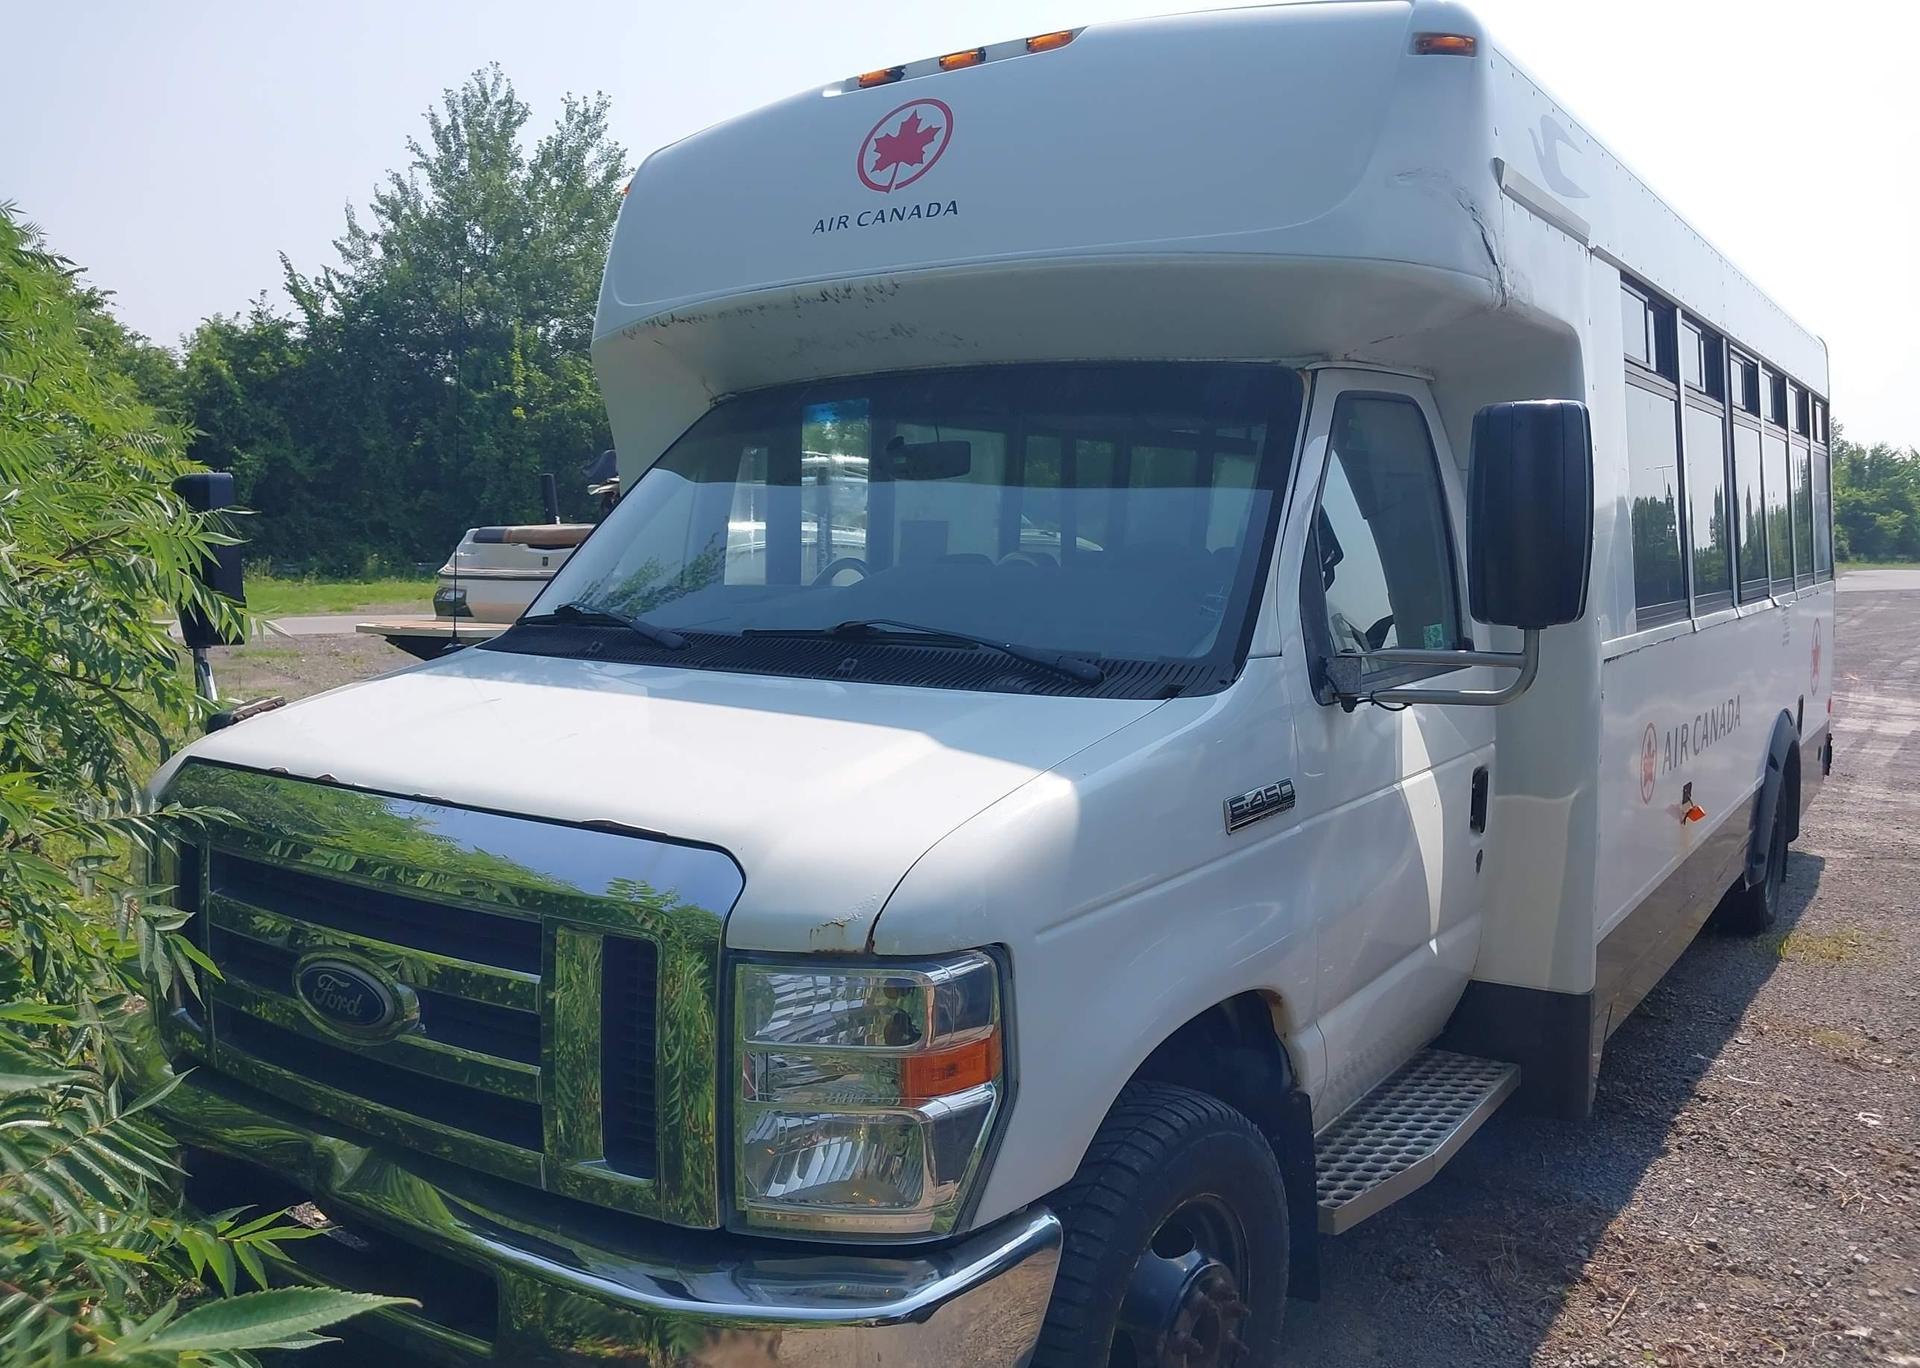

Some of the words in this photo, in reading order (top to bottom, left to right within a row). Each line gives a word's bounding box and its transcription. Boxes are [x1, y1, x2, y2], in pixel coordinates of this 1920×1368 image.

[812, 214, 850, 234] AIR
[856, 200, 959, 227] CANADA
[1662, 723, 1689, 775] AIR
[1693, 694, 1741, 755] CANADA
[313, 973, 364, 1017] Ford
